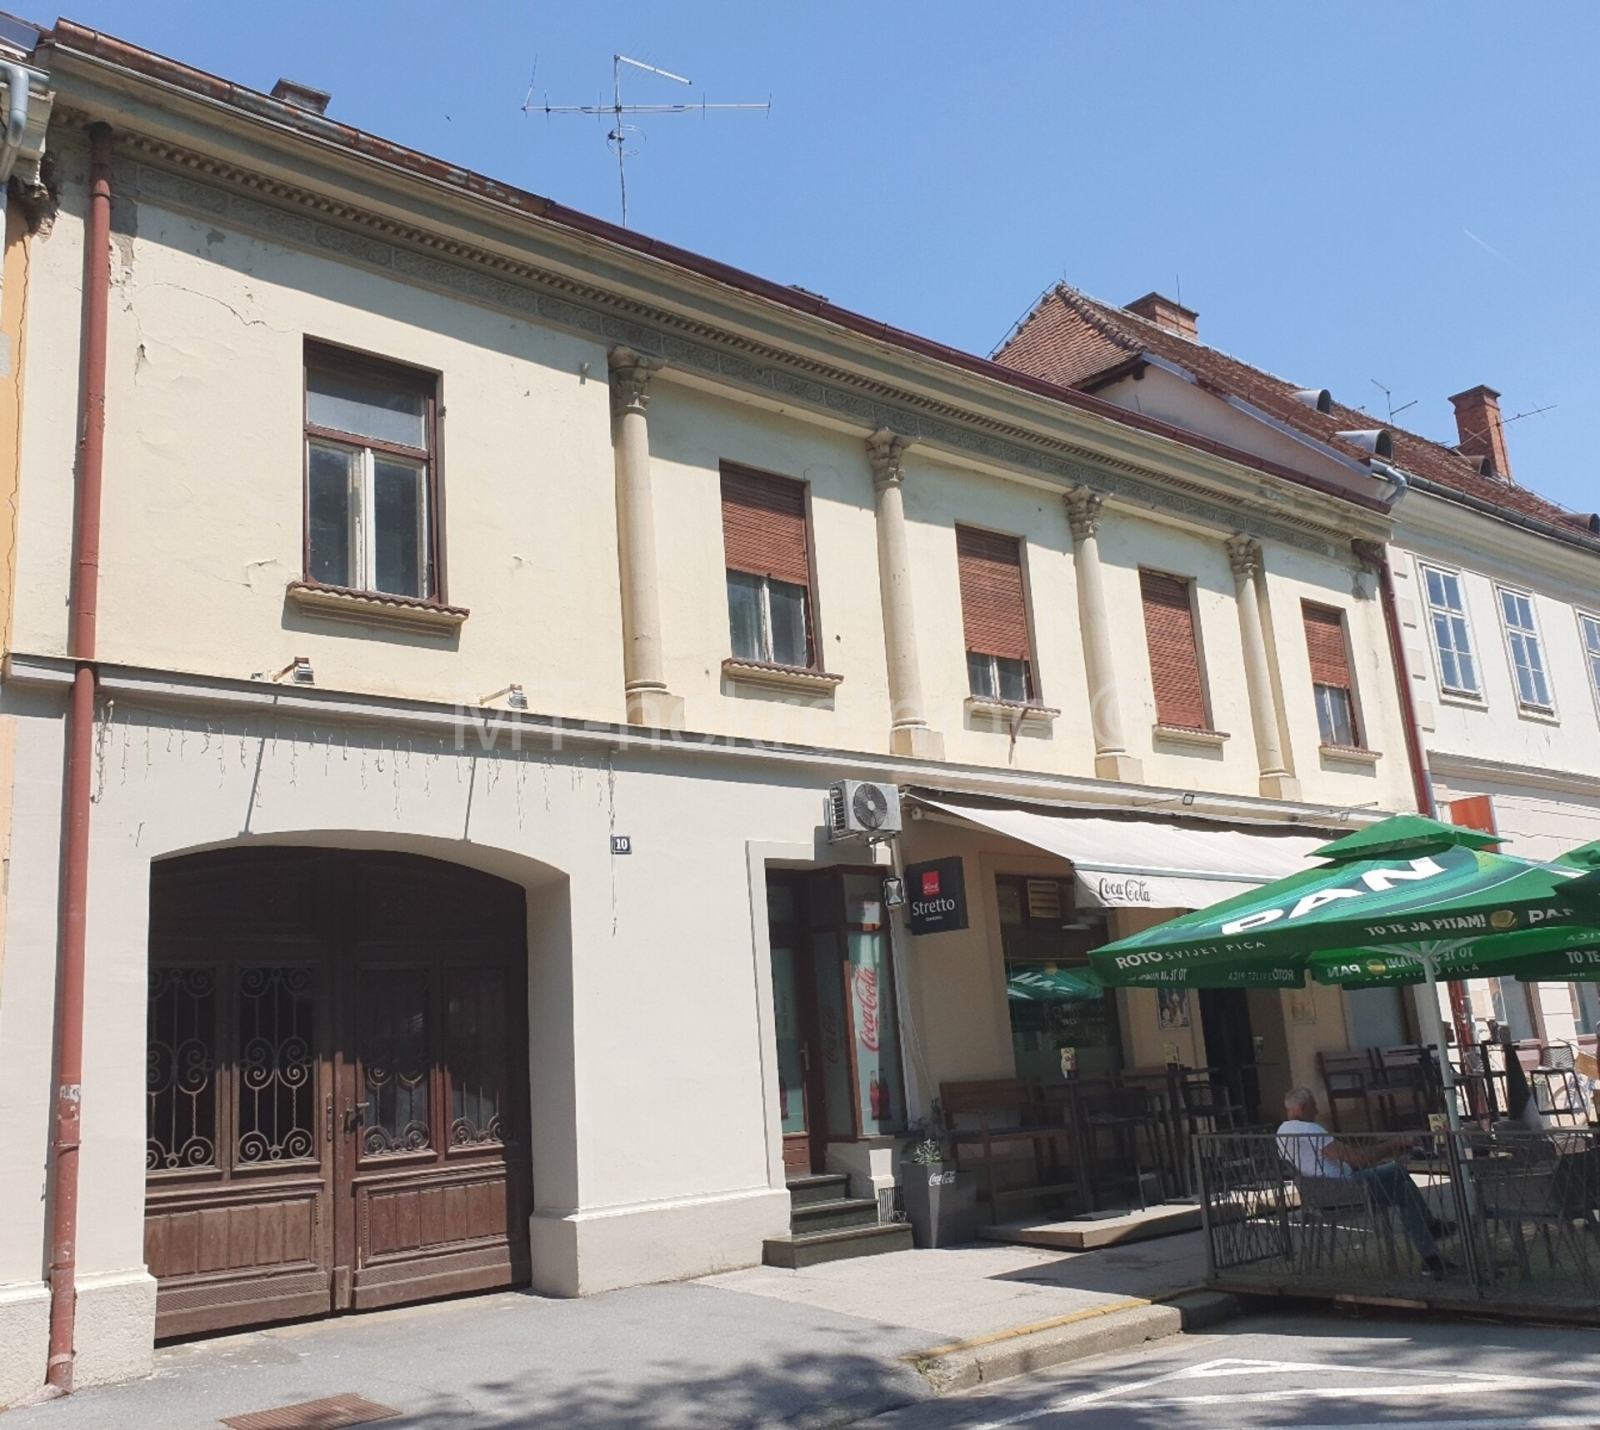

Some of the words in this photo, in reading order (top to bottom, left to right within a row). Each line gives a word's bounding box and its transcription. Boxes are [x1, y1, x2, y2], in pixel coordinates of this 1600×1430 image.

[615, 838, 628, 850] 10
[1220, 855, 1448, 935] PAN
[912, 898, 956, 916] Stretto
[1364, 926, 1386, 937] TO
[1387, 923, 1407, 933] TE
[1410, 920, 1432, 932] JA
[1432, 914, 1487, 930] PITAM!
[1115, 951, 1163, 969] ROTO
[1163, 947, 1219, 961] SVIJET
[1225, 941, 1267, 952] PICA
[1566, 951, 1584, 964] TO
